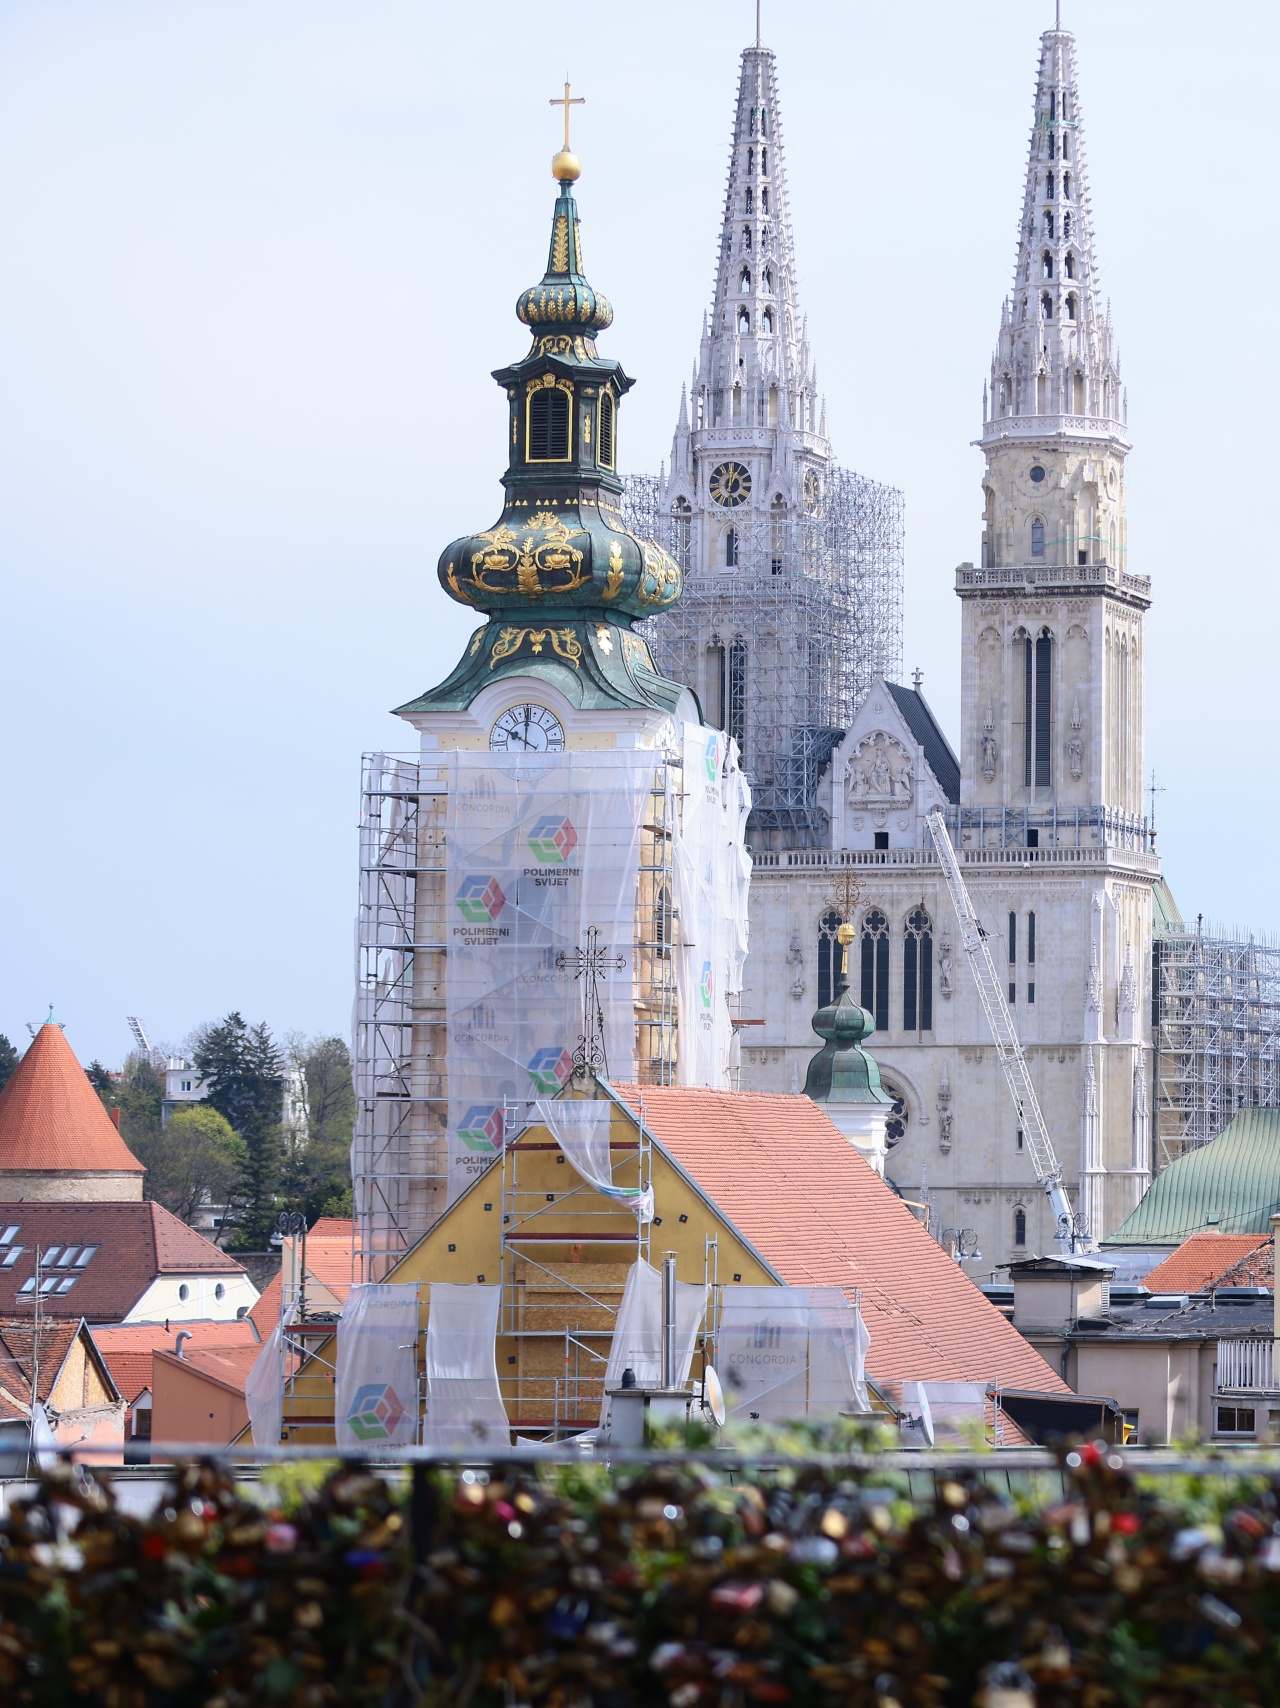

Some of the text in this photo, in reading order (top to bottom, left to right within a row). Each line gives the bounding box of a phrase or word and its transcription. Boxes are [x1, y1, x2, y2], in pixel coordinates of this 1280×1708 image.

[456, 803, 511, 814] CONCORDIA
[523, 868, 580, 876] POLIMERNI
[534, 878, 569, 887] SVIJET
[453, 927, 510, 937] POLIMERNI
[464, 937, 499, 946] SVIJET
[454, 1033, 509, 1042] CONCORDIA
[466, 1166, 486, 1175] SVI
[729, 1353, 797, 1365] CONCORDIA
